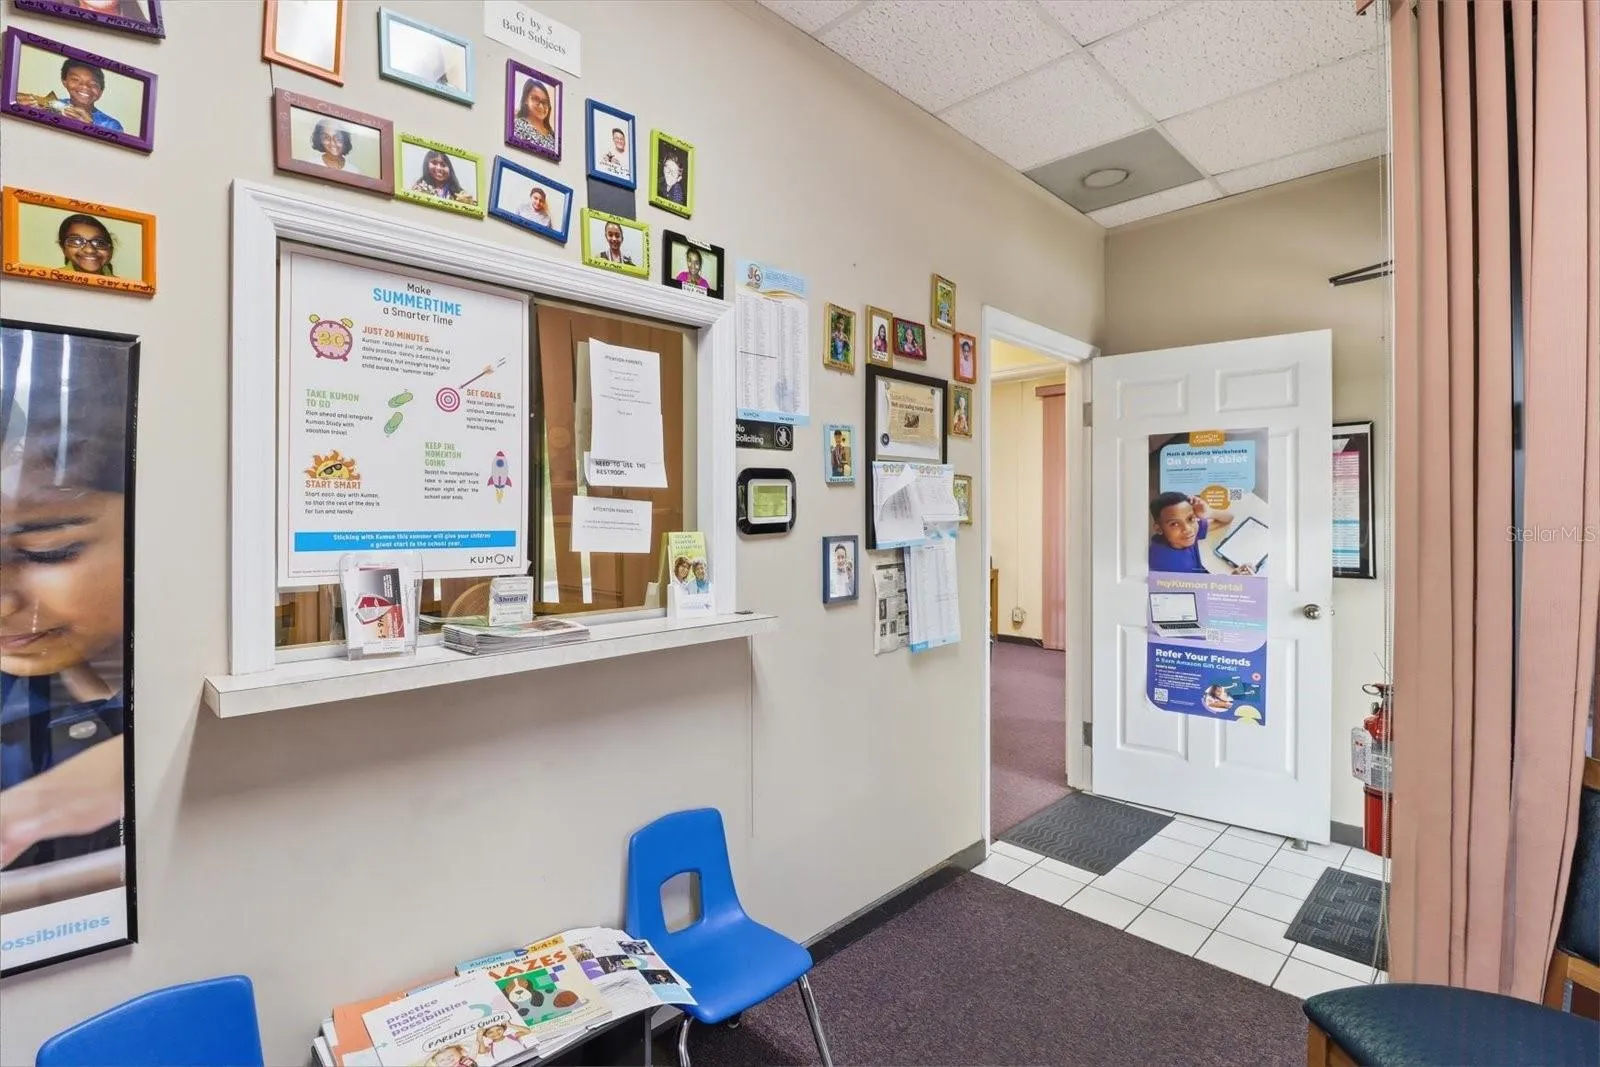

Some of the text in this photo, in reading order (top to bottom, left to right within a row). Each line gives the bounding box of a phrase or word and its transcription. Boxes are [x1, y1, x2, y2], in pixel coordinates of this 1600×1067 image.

[516, 11, 525, 23] G
[530, 17, 541, 31] by
[502, 18, 566, 55] Both Subjects
[50, 269, 89, 285] Reading
[407, 283, 431, 295] Make
[373, 287, 462, 316] SUMMERTIME
[392, 307, 430, 321] Smarter
[433, 315, 453, 325] Time
[362, 326, 429, 342] JUST 20 MINUTES
[362, 346, 374, 354] daily
[306, 389, 359, 401] TAKE KUMON
[466, 389, 501, 399] SET GOALS
[306, 399, 316, 407] TO
[736, 424, 745, 432] No
[736, 434, 763, 445] Soliciting
[425, 459, 446, 467] GOING
[1212, 455, 1248, 464] Tablet
[305, 480, 360, 489] START SMART
[470, 553, 514, 564] KUMON
[1157, 579, 1243, 591] myKumon Portal
[1156, 648, 1251, 667] Refer Your Friends
[1, 915, 111, 951] ossibilities
[499, 955, 529, 968] Book of
[386, 999, 438, 1025] practice
[391, 1000, 469, 1037] possibilities
[388, 1009, 431, 1030] makes
[427, 1025, 476, 1049] PARENT'S
[477, 1013, 506, 1029] GUIDE
